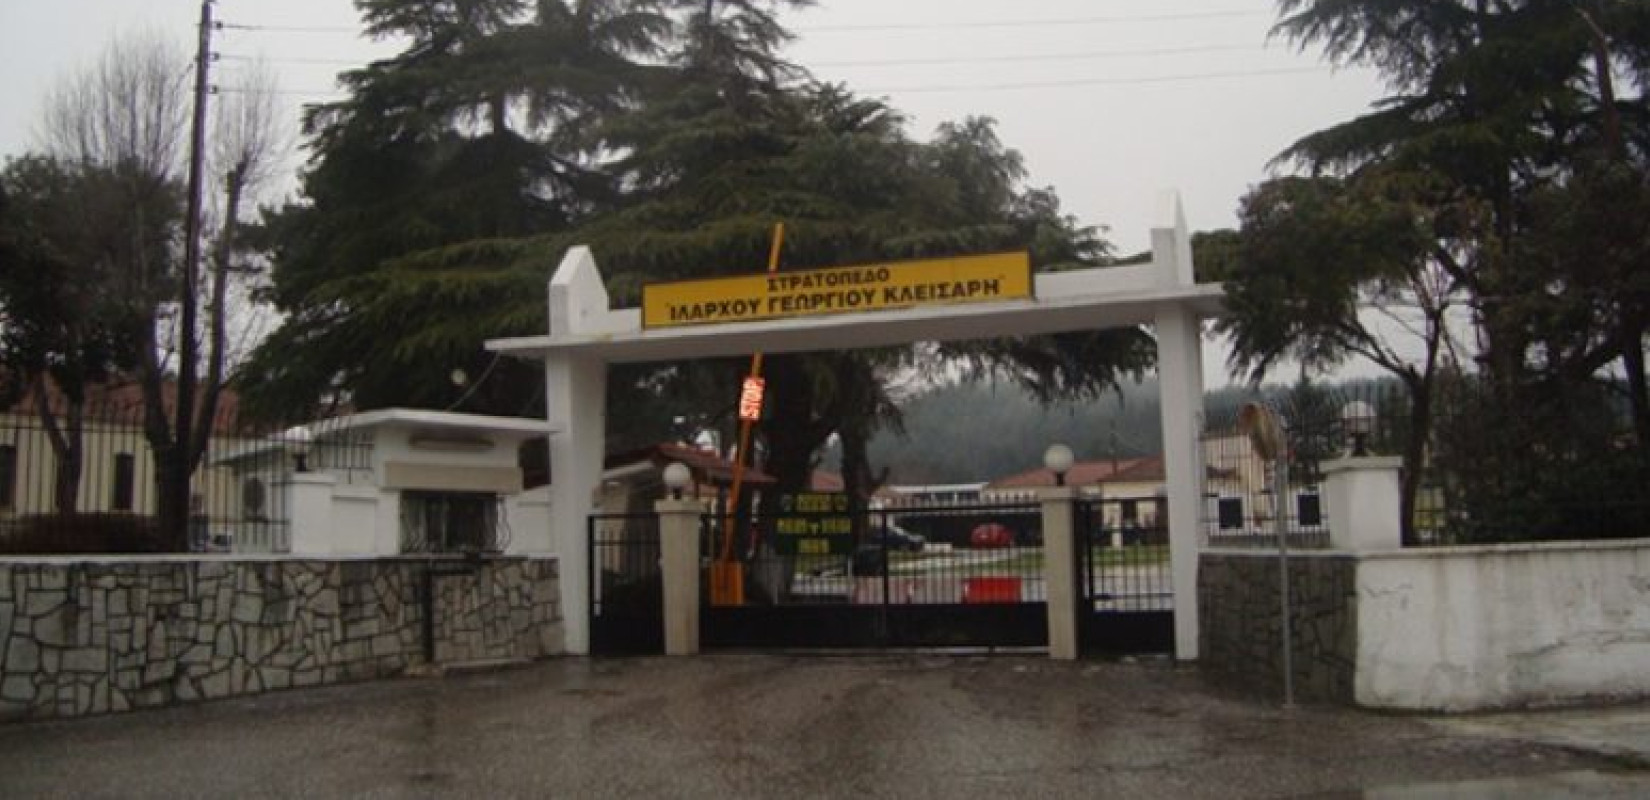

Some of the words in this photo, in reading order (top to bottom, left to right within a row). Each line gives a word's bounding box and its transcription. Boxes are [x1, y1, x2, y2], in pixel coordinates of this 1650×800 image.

[767, 268, 889, 292] ΣΤΡΑΤΟΠΕΔΟ
[767, 288, 876, 313] ΓΕΩΡΓΙΟΥ
[740, 378, 764, 420] STOP
